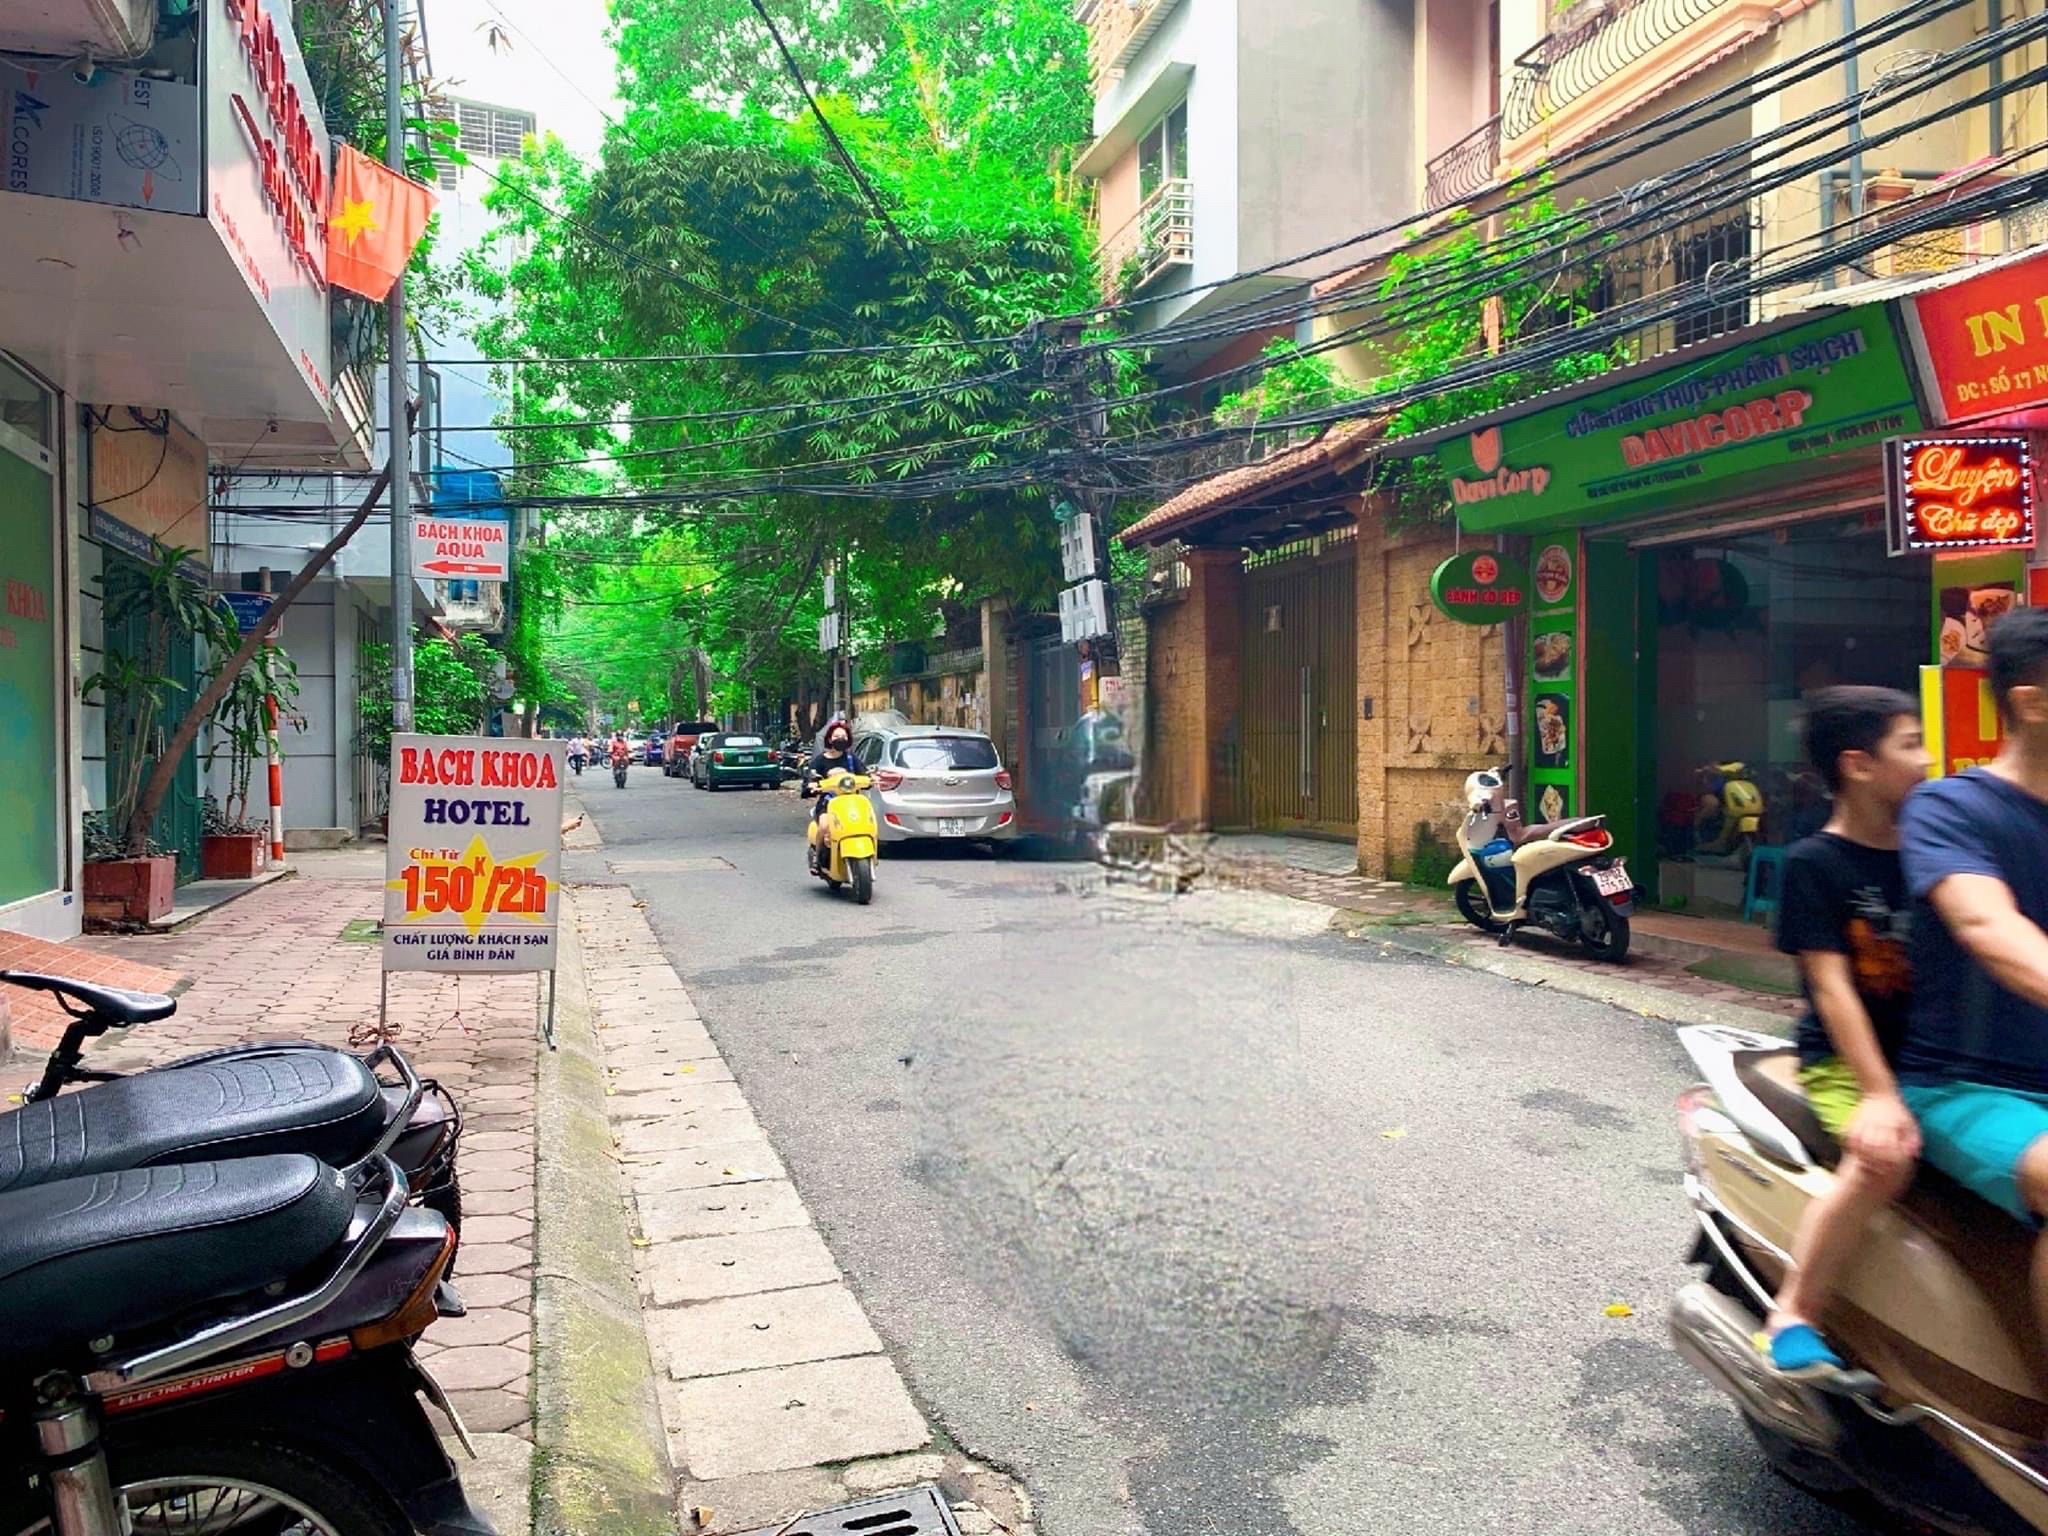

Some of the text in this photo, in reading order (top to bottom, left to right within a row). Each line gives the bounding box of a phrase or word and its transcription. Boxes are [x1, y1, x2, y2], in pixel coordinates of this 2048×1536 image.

[1965, 304, 2025, 356] IN
[1791, 331, 1863, 376] SẠCH
[1989, 366, 2011, 394] SỐ
[2013, 371, 2032, 389] 17
[1620, 389, 1812, 468] DAVICORP
[1912, 447, 2018, 506] Luyện
[463, 526, 503, 542] KHOA
[1920, 505, 1977, 534] Chữ
[435, 542, 485, 558] AQUA
[481, 751, 558, 789] KHOA
[424, 798, 530, 826] HOTEL
[393, 930, 549, 947] CHẤT LƯỢNG KHÁCH SẠN
[427, 948, 449, 960] GIÁ
[453, 947, 484, 960] BÌNH
[118, 1366, 256, 1407] ELECTRIC STARTER
